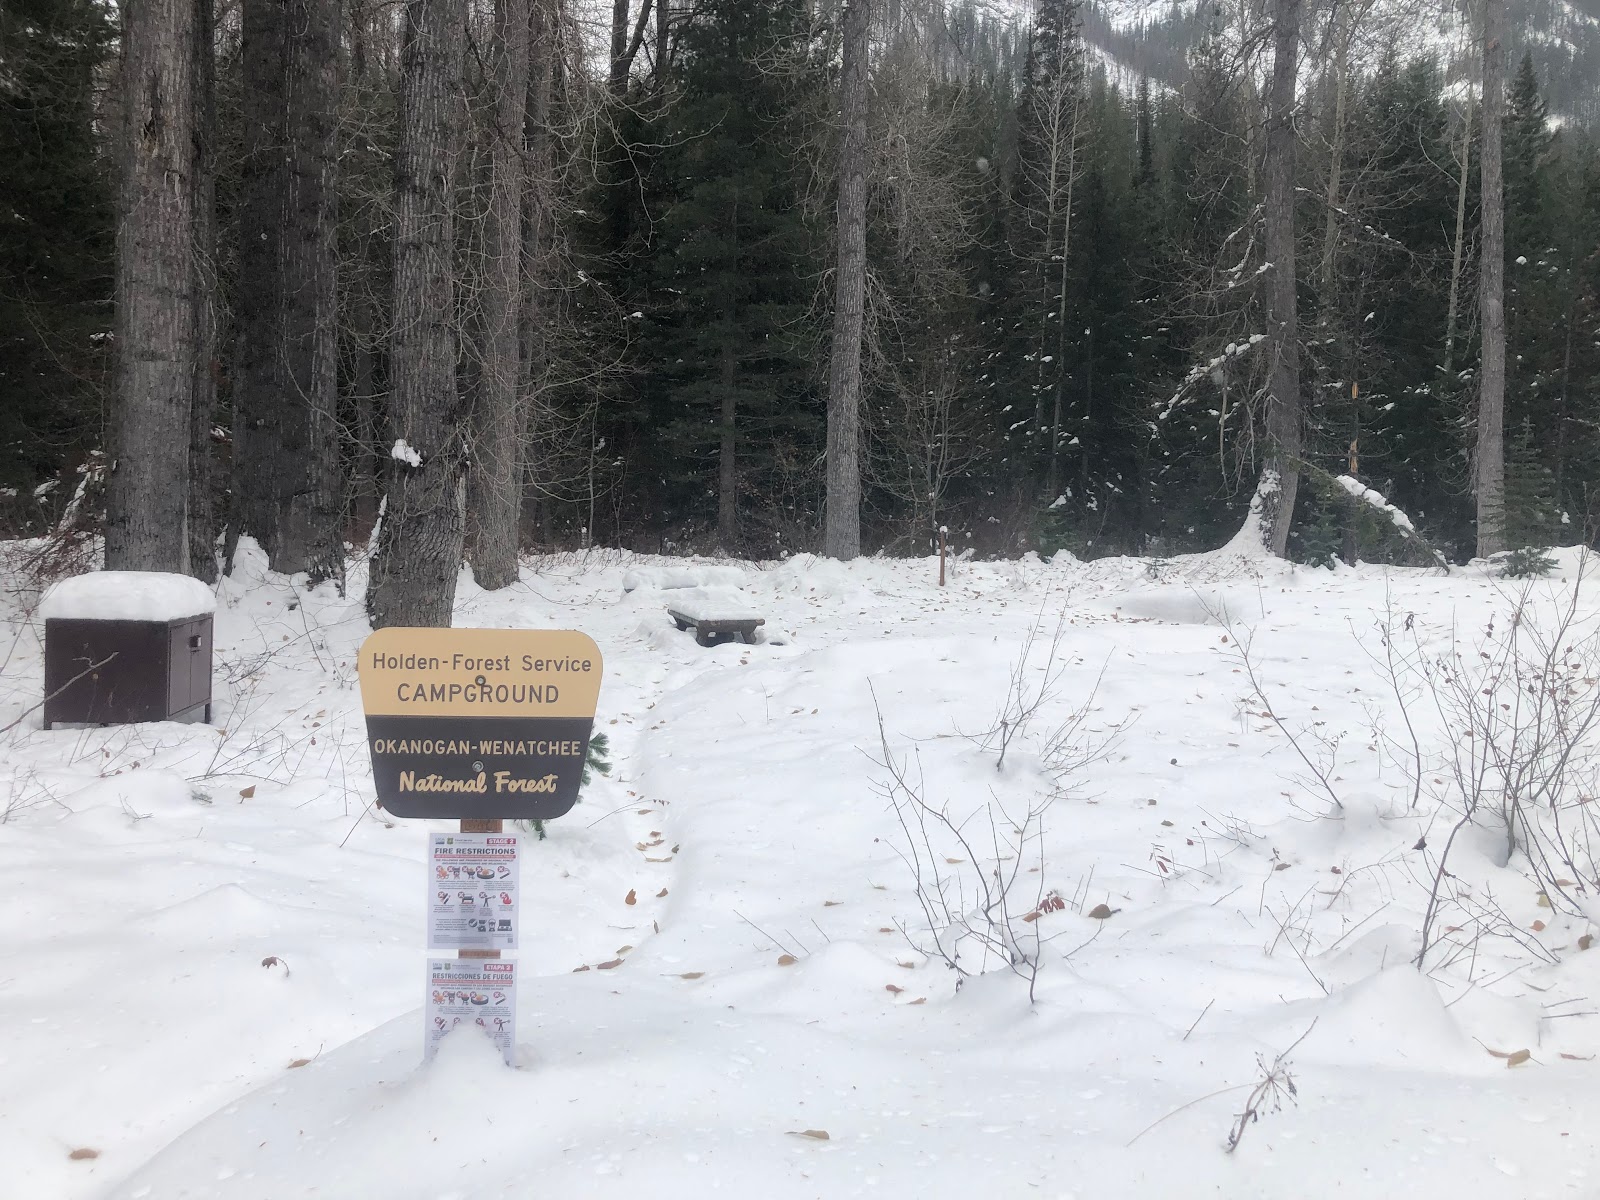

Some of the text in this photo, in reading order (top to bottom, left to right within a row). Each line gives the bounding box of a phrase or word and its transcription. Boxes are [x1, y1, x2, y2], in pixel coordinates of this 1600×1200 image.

[373, 652, 592, 672] Holden-Forest Service
[397, 683, 559, 703] CAMPGROUND
[374, 739, 581, 756] OKANOGAN-WENATCHEE
[399, 770, 559, 793] National Forest
